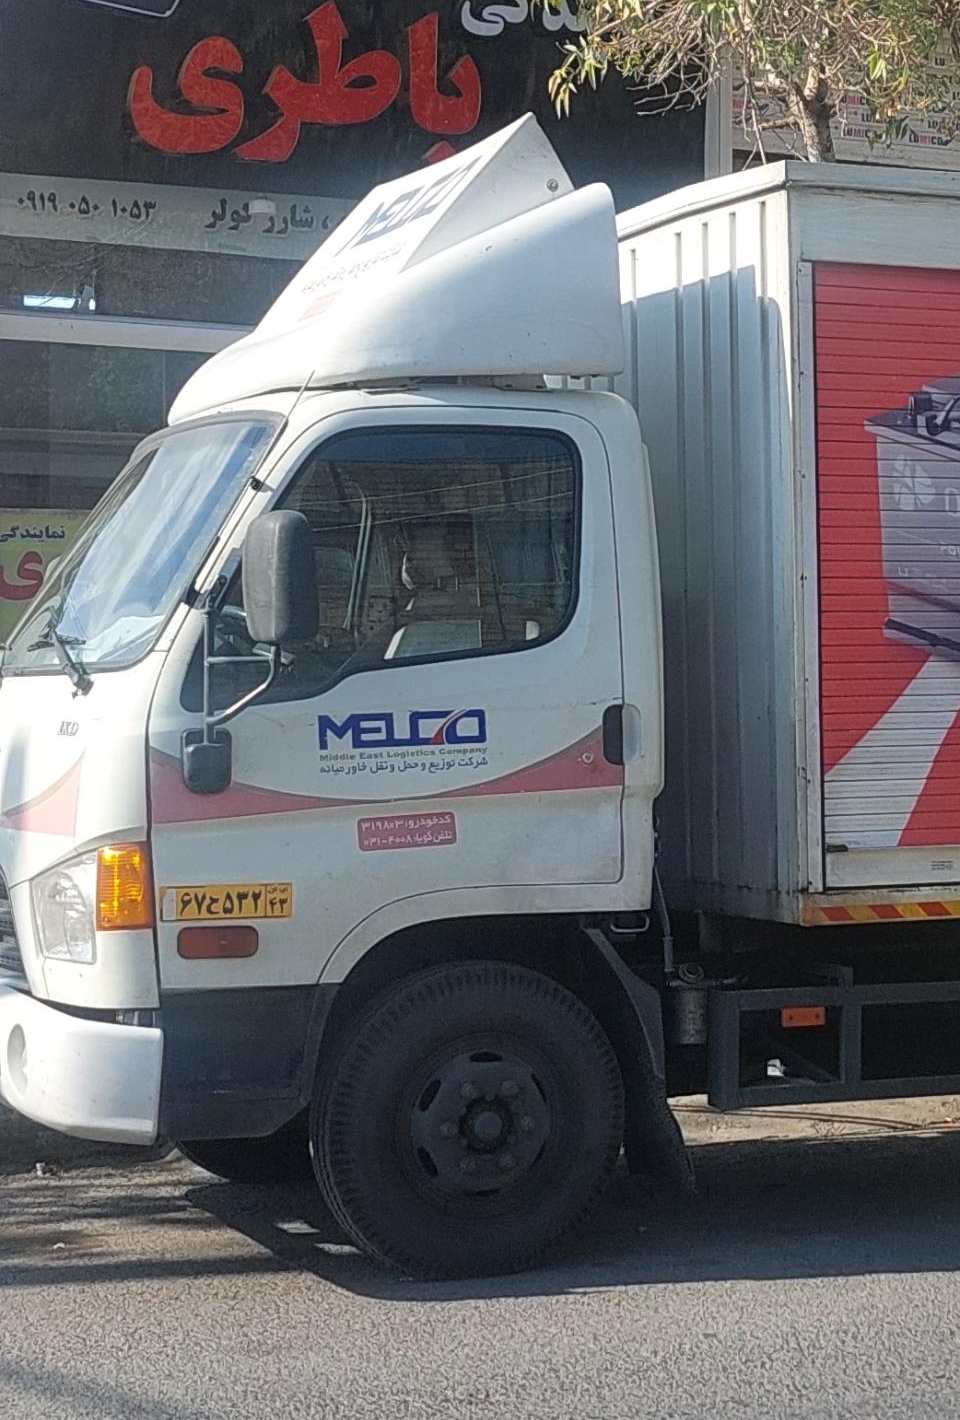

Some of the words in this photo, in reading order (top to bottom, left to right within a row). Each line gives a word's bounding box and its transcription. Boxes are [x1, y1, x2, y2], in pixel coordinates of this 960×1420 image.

[130, 0, 482, 163] باطری
[18, 190, 58, 212] ۰۹۱۹
[69, 194, 100, 215] ۰۵۰
[112, 197, 157, 220] ۱۰۵۳
[318, 709, 487, 750] MELCO
[320, 752, 356, 762] Middle
[360, 751, 383, 760] East
[387, 749, 435, 759] Logistics
[439, 746, 488, 756] Company
[370, 759, 388, 774] نقل
[397, 760, 419, 773] حمل
[428, 758, 455, 774] توزیع
[457, 756, 488, 769] شرکت
